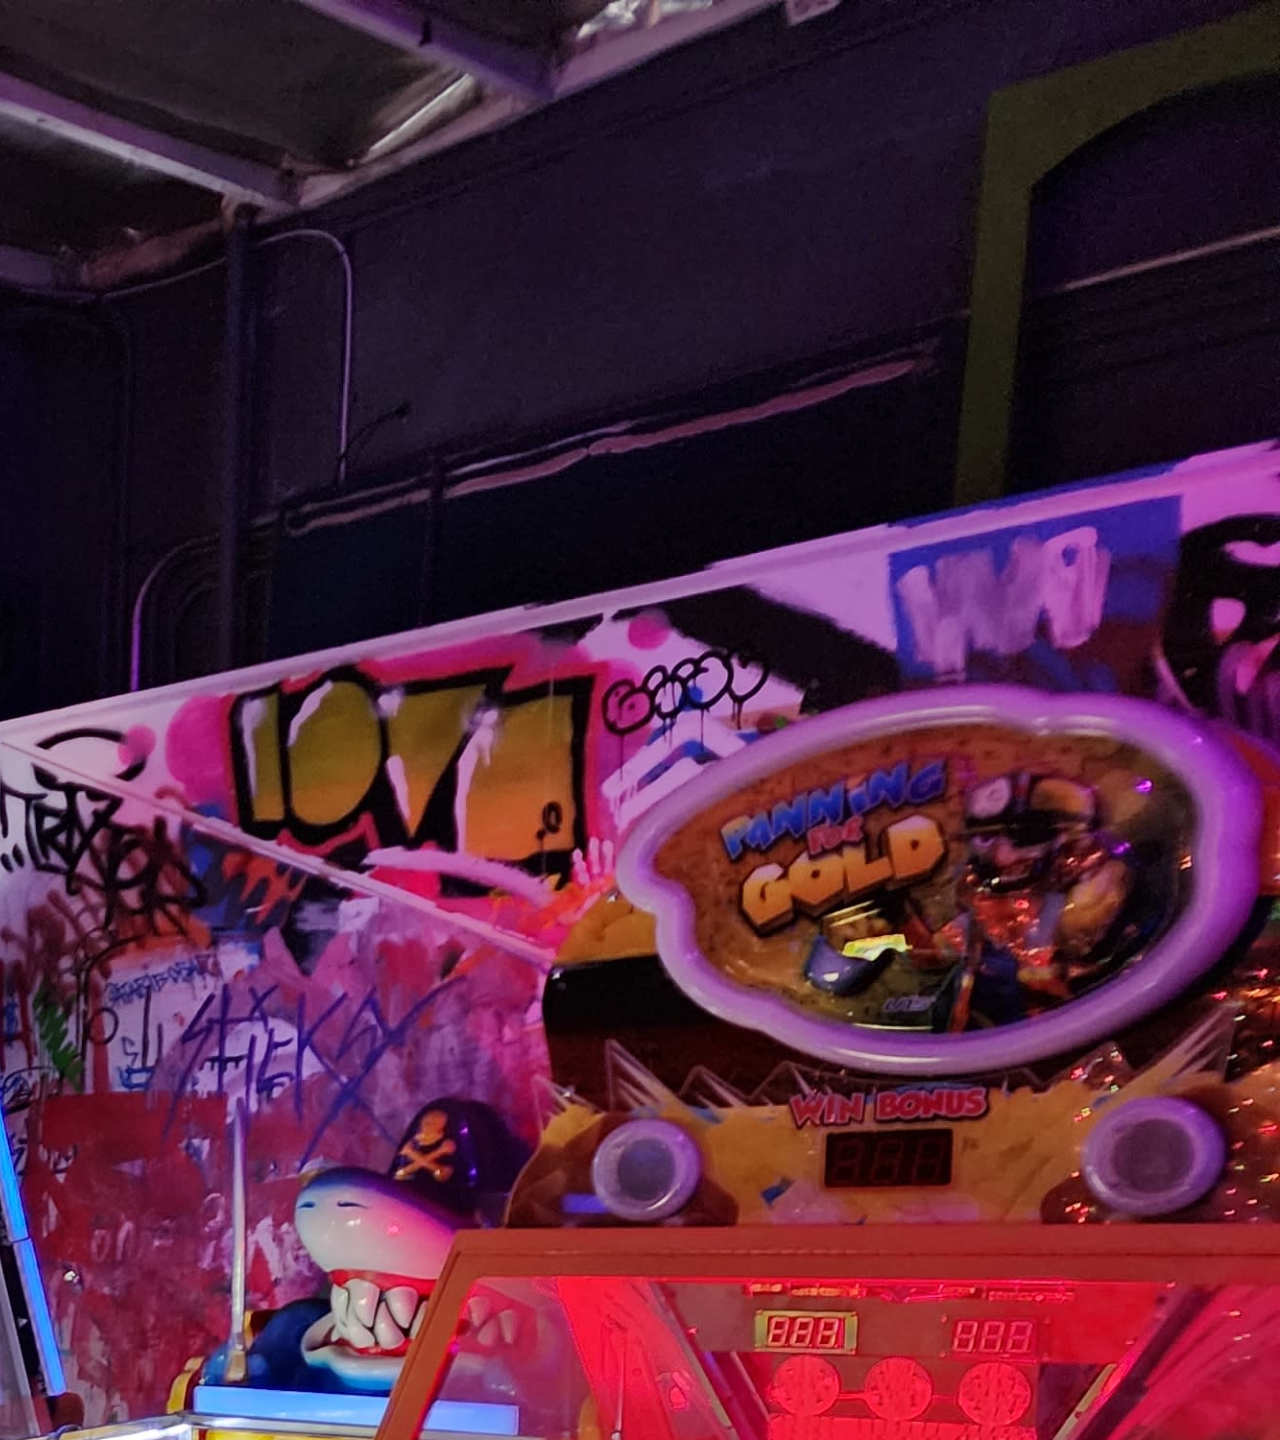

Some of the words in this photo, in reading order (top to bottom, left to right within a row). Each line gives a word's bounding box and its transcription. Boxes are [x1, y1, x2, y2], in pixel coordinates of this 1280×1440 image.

[741, 815, 946, 932] GOLD
[790, 1091, 865, 1129] WIN
[875, 1087, 989, 1122] BONUS
